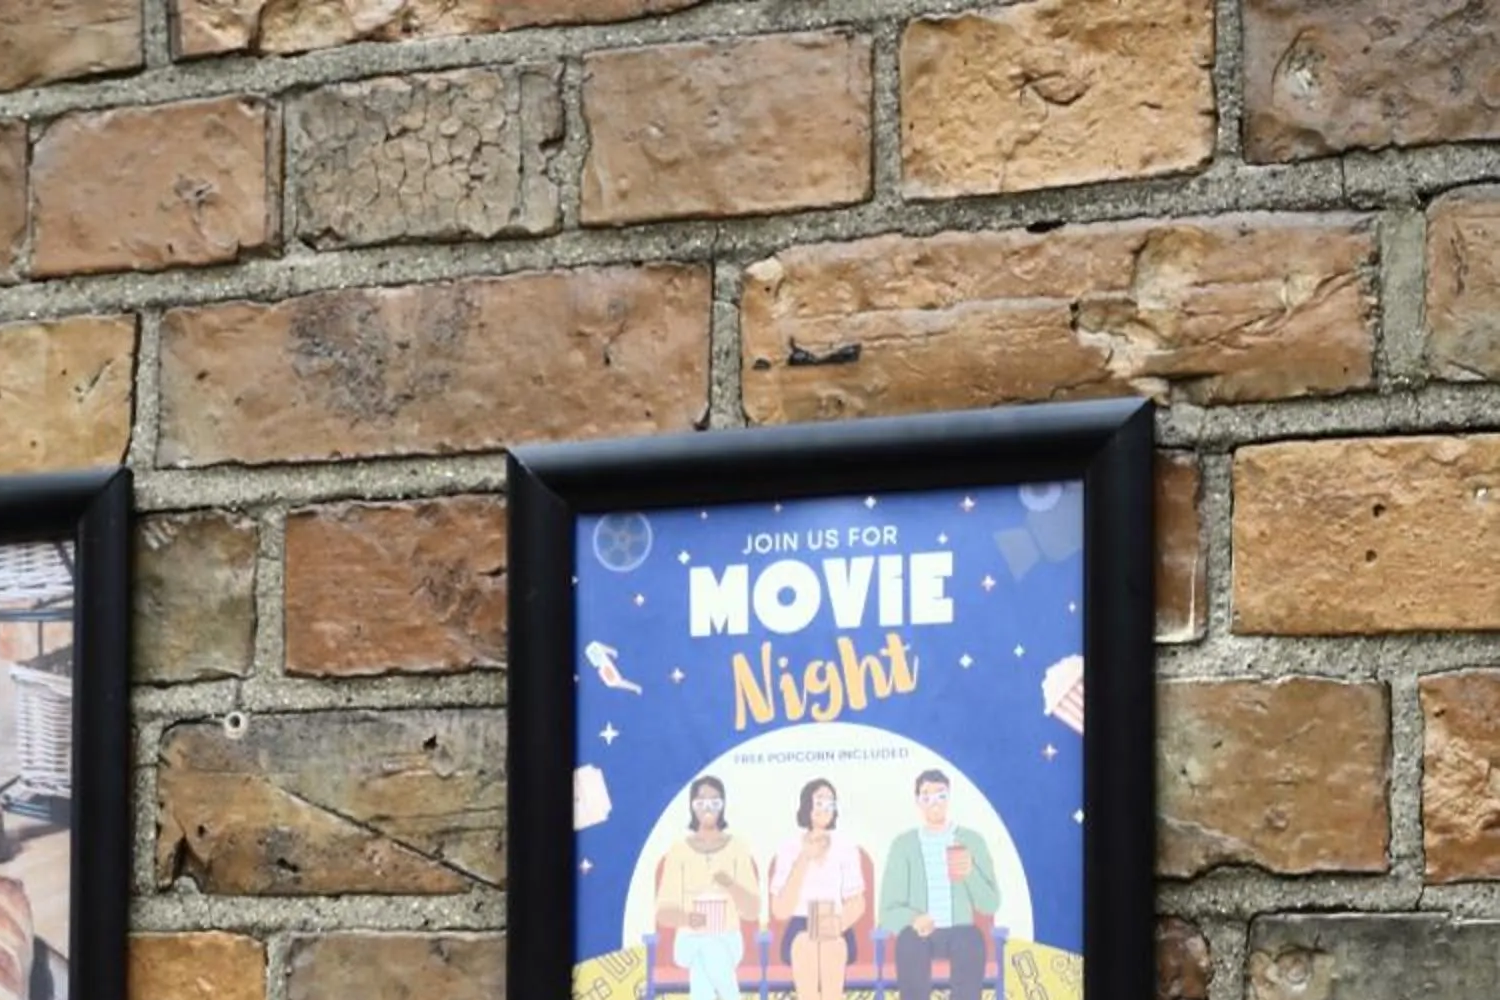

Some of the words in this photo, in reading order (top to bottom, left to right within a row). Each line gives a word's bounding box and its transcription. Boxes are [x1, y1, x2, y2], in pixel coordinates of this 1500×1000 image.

[742, 531, 798, 556] JOIN
[807, 529, 840, 550] US
[848, 525, 899, 548] FOR
[689, 550, 955, 638] MOVIE
[731, 632, 920, 731] Night
[767, 749, 835, 764] POPCORN
[838, 747, 910, 763] INCLUDED
